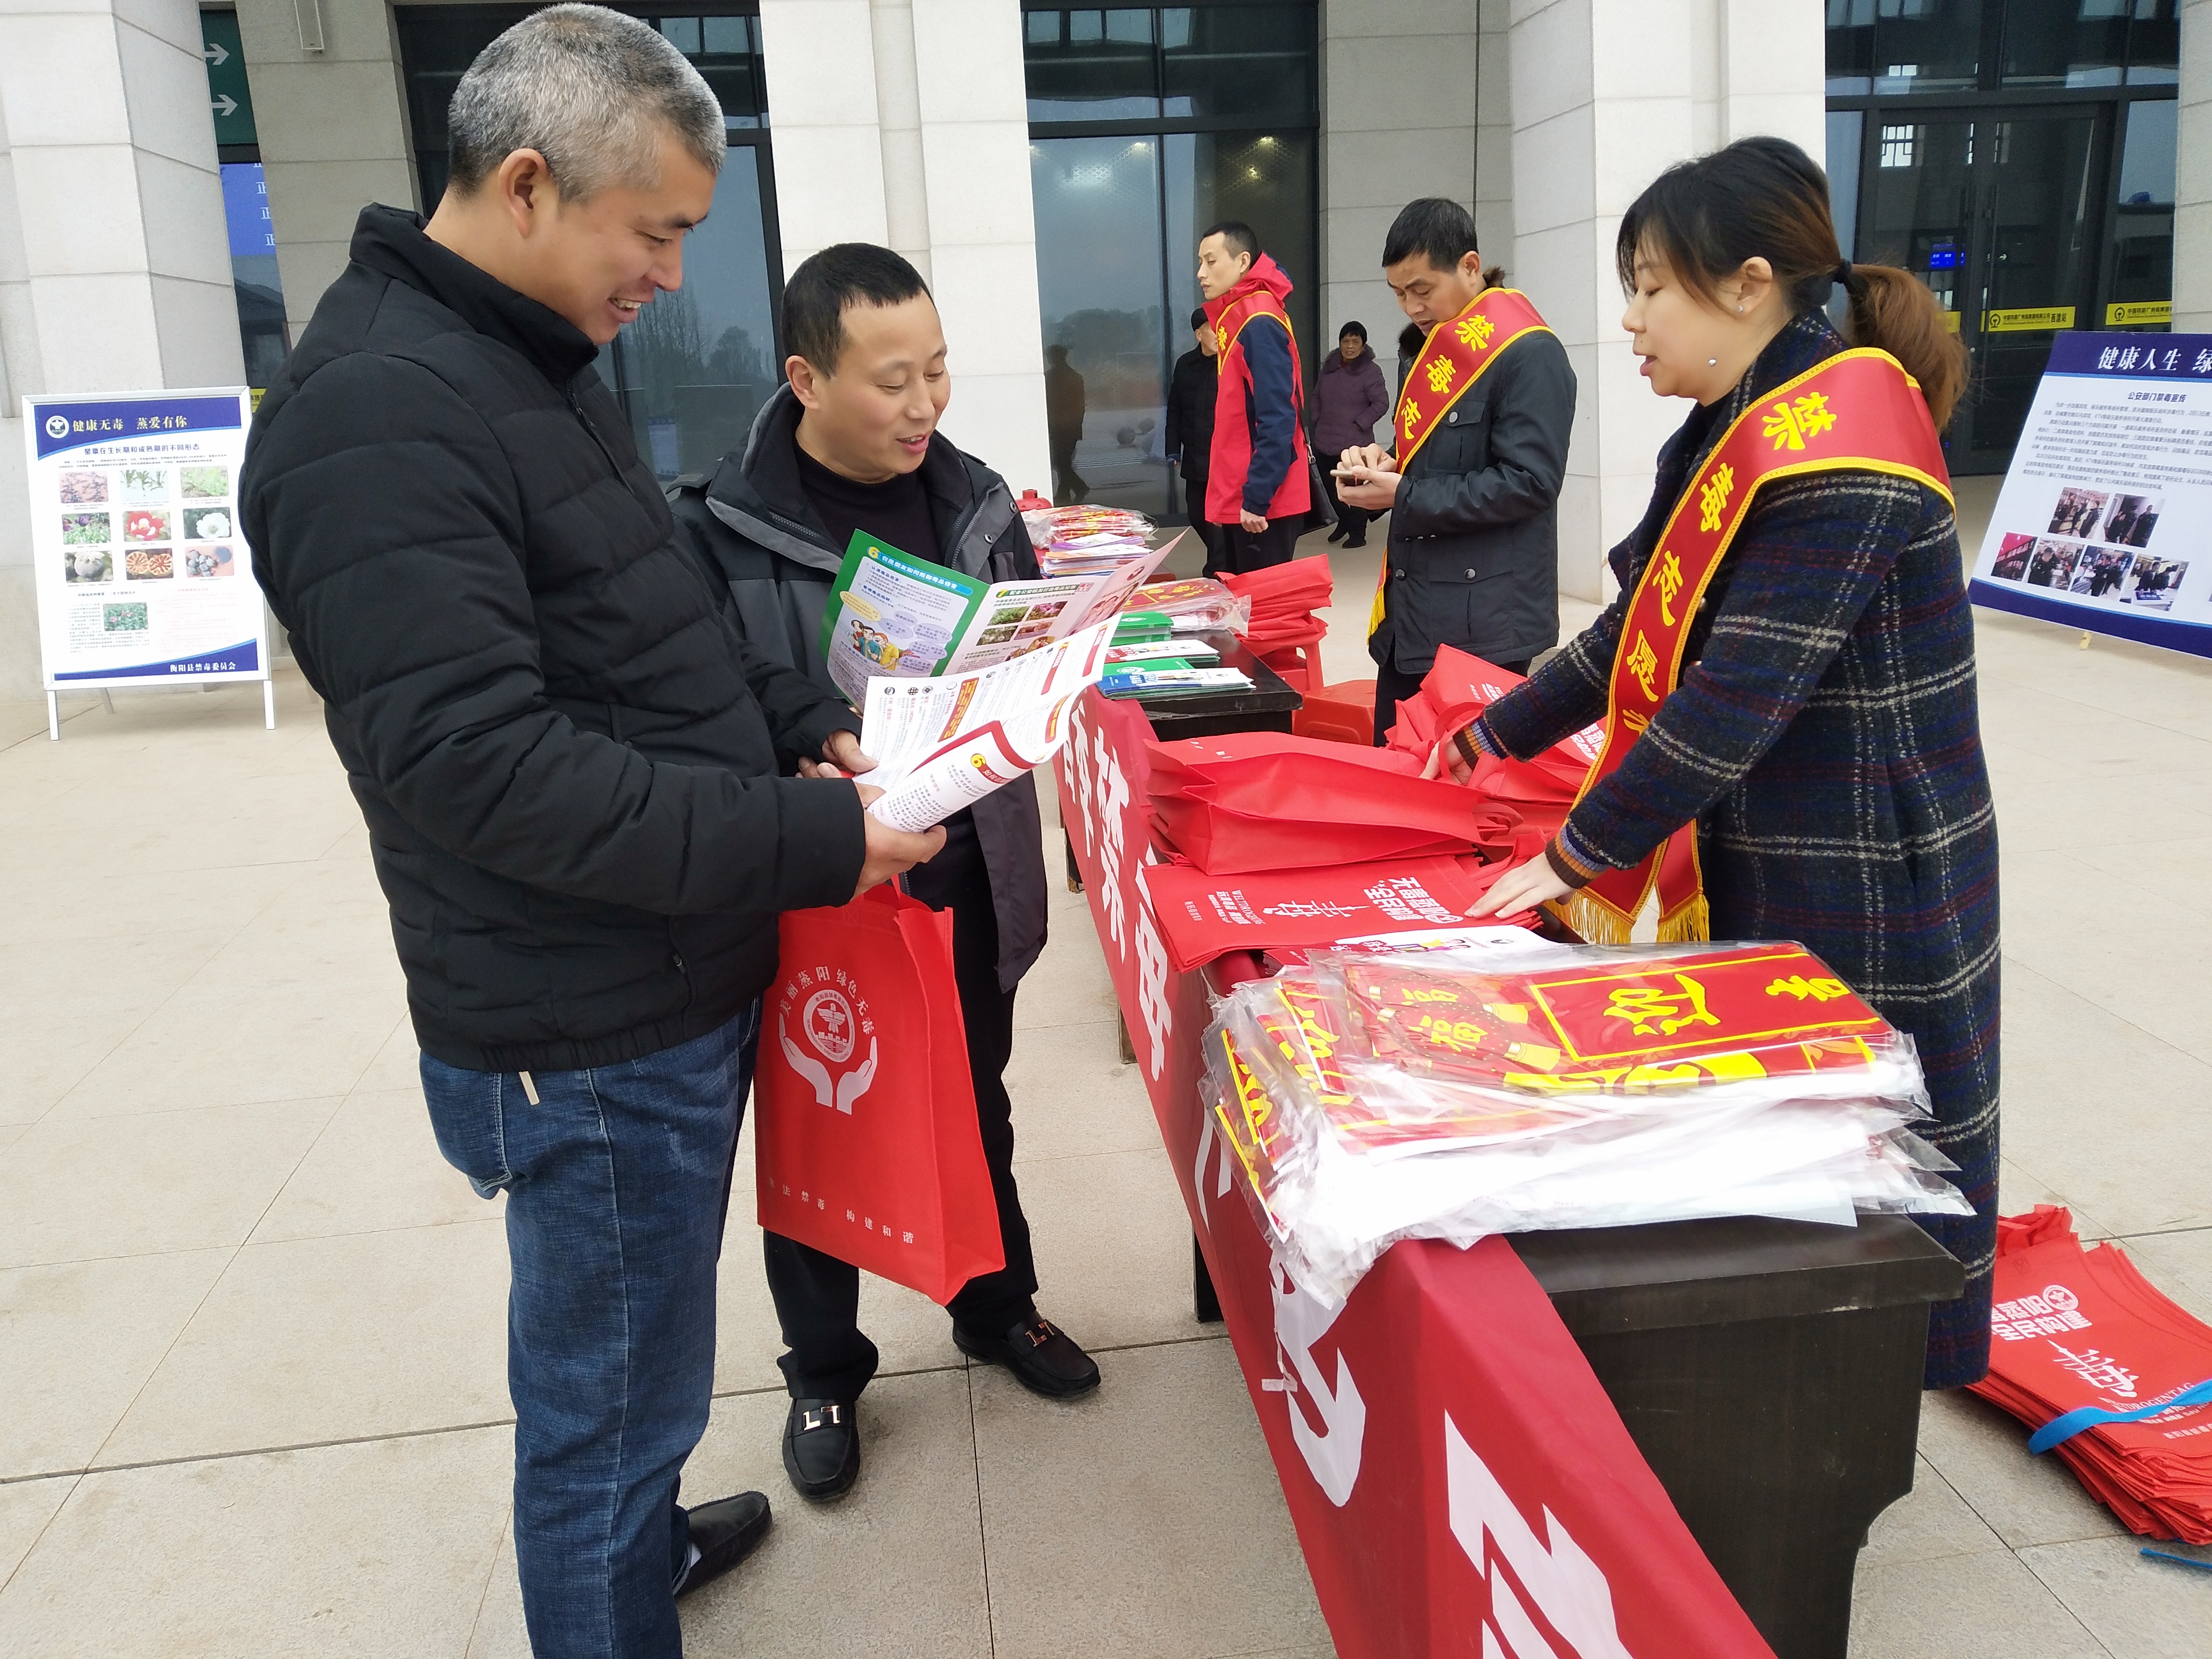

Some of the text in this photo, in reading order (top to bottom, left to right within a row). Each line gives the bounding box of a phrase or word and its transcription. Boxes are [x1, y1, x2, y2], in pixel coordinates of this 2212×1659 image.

[2097, 346, 2182, 372] 健康人生
[2128, 391, 2187, 403] 公安部门禁毒宣传
[73, 416, 187, 432] 健康无毒 蒸爱有你
[84, 444, 200, 455] 罂粟在生长期和成熟期的不同形态
[881, 555, 958, 589] 农民朋友如何抵御毒品侵害
[170, 662, 236, 673] 衡阳县禁毒委员会
[970, 753, 986, 768] 6
[1363, 887, 1424, 921] 全民构建
[779, 965, 875, 1035] 美丽蒸阳 绿色无毒
[846, 1209, 914, 1244] 构建和谐
[1993, 1310, 2093, 1342] 全民构建
